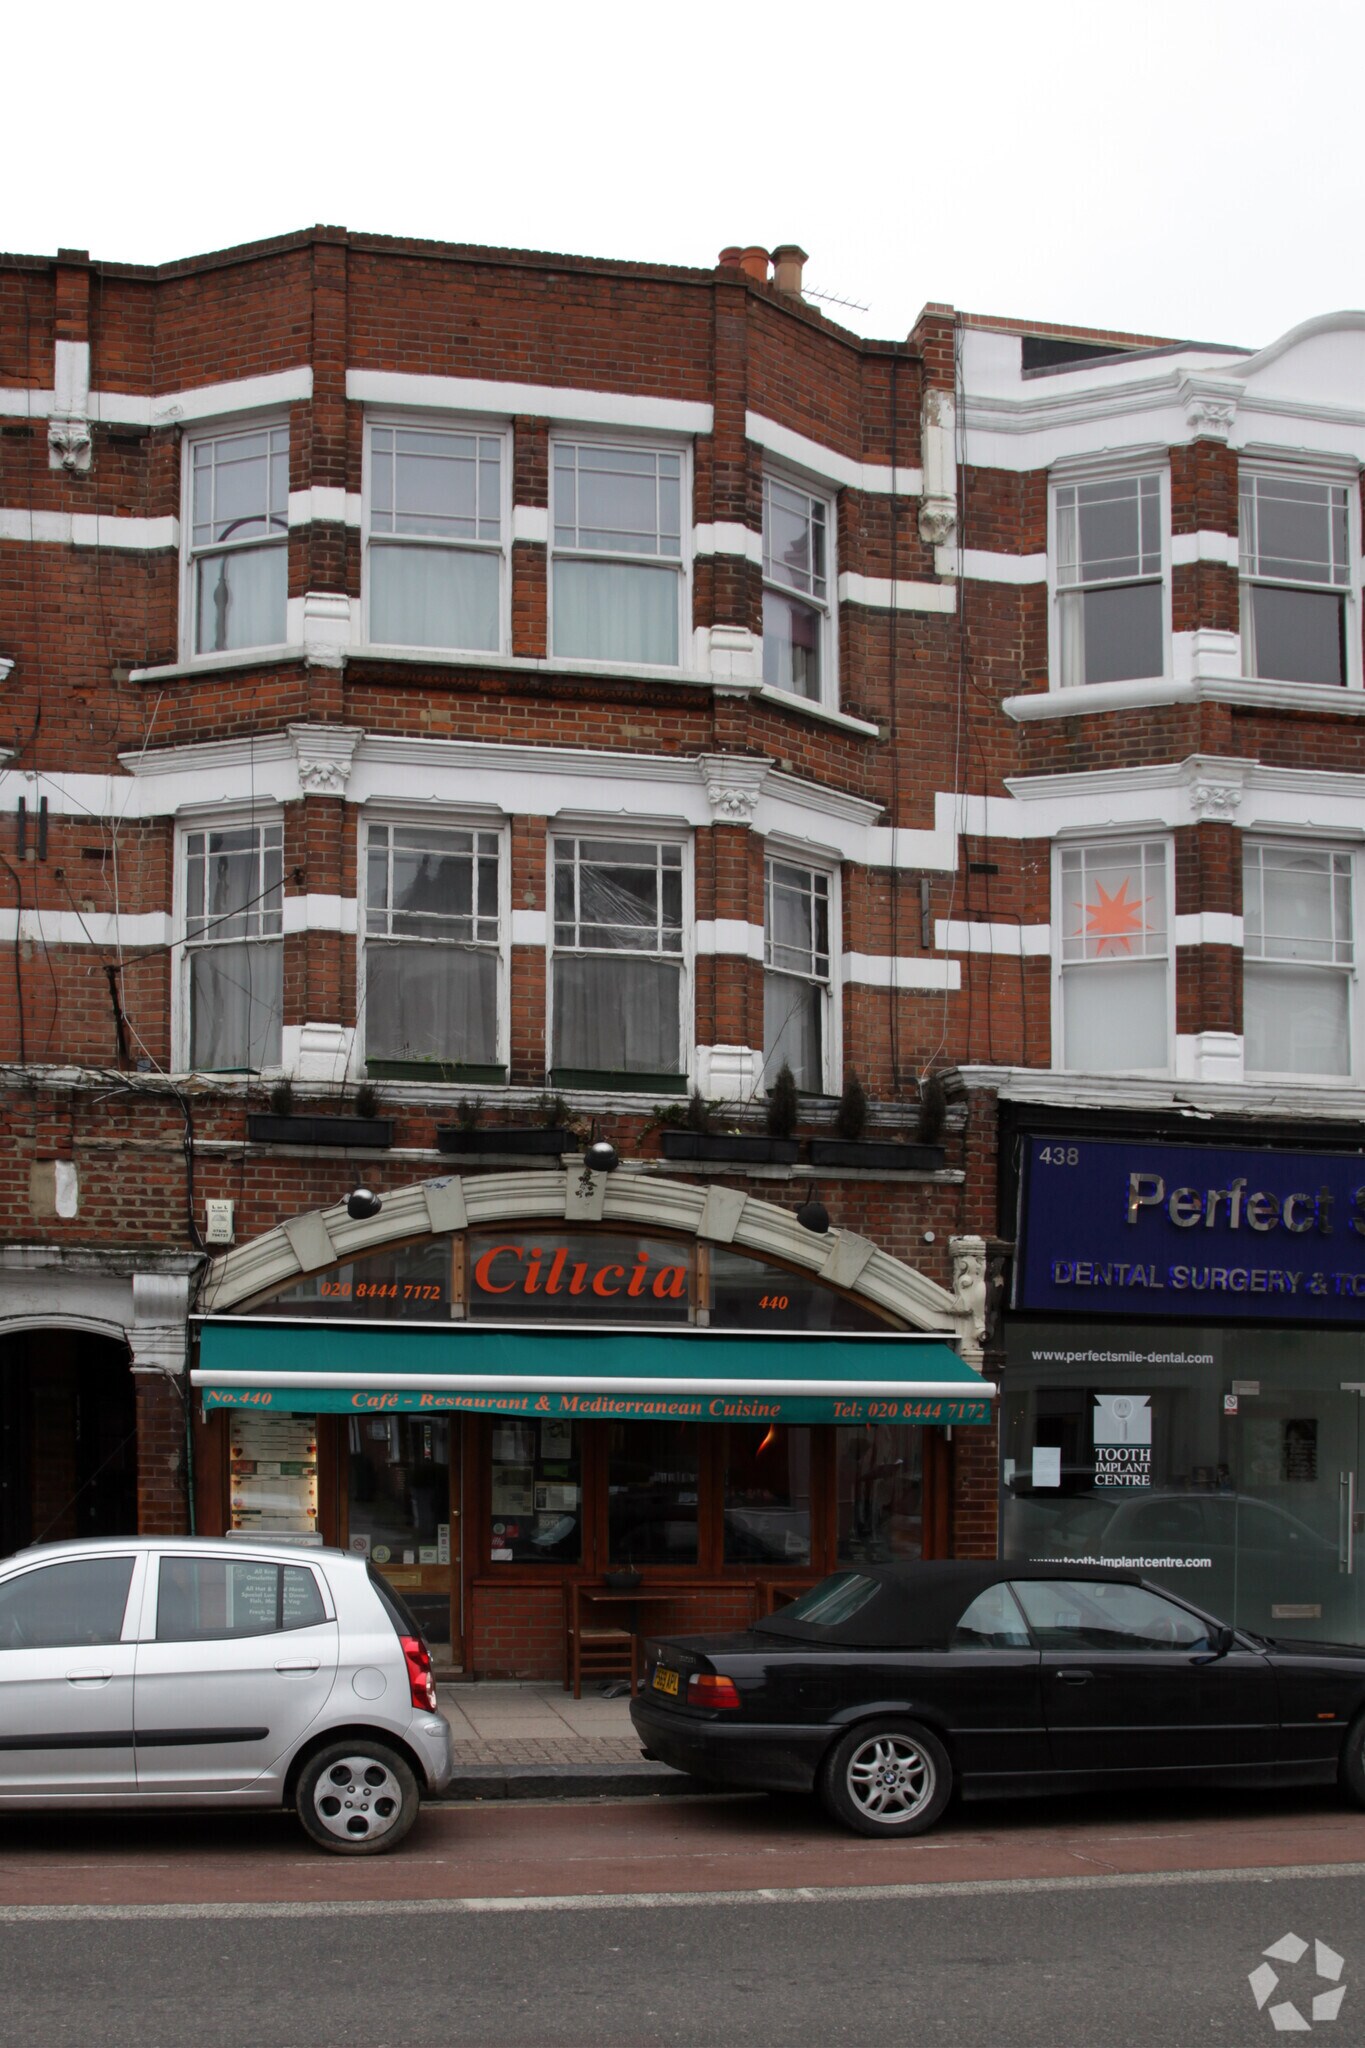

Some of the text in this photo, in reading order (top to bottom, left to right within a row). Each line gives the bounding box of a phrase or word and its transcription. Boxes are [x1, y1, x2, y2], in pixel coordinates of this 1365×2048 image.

[1039, 1147, 1079, 1165] 438
[1127, 1172, 1334, 1233] Perfect
[1054, 1260, 1164, 1288] DENTAL
[1171, 1264, 1302, 1294] SURGERY
[1309, 1272, 1329, 1295] &
[320, 1282, 441, 1300] 020 8444 7172
[758, 1295, 789, 1310] 440
[1031, 1349, 1214, 1365] www.perfectsmile-dental.com
[207, 1390, 273, 1405] No.440
[351, 1392, 399, 1411] Café
[419, 1393, 528, 1411] Restaurant
[534, 1395, 551, 1411] &
[558, 1395, 702, 1416] Mediterranean
[708, 1398, 781, 1417] Cuisine
[833, 1402, 985, 1419] Tel: 020 8444 7172
[1094, 1447, 1151, 1462] TOOTH
[1094, 1462, 1151, 1473] IMPLANT
[1094, 1473, 1151, 1486] CENTRE
